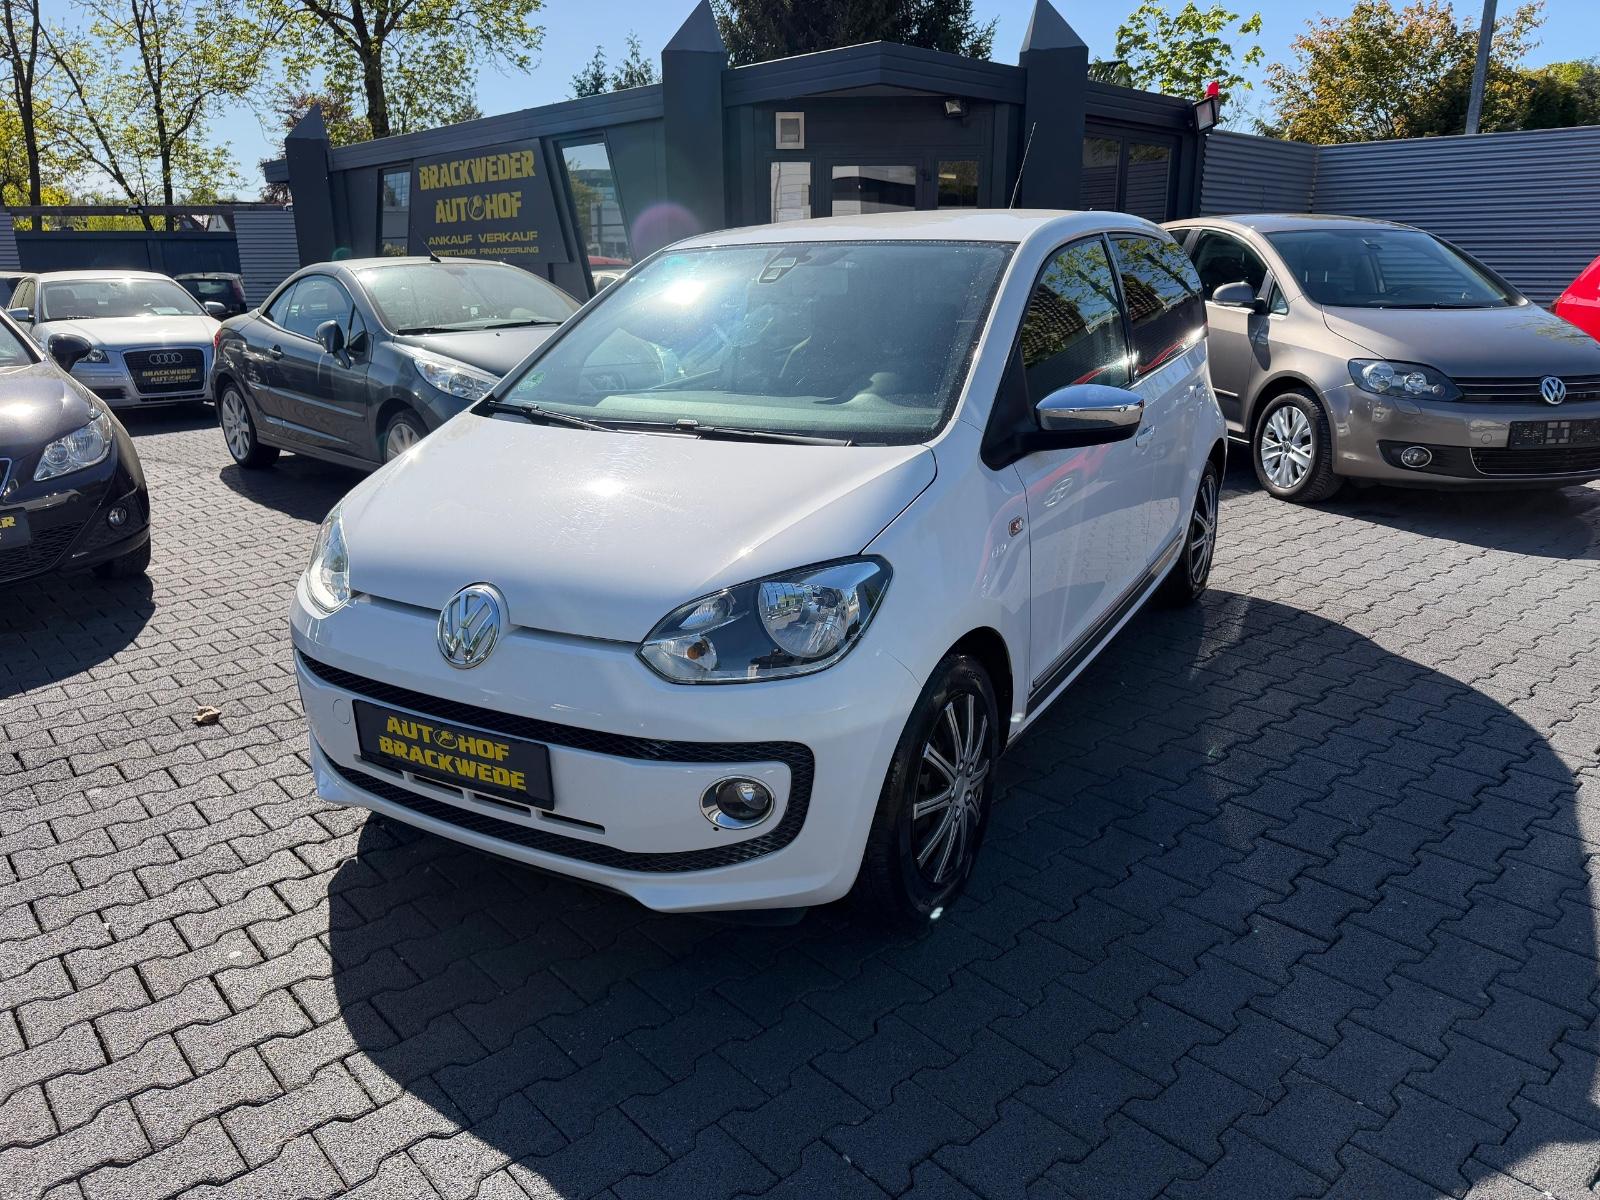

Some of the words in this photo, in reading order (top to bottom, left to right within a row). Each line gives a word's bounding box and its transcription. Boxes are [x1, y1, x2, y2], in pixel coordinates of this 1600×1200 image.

[419, 150, 536, 190] BRACKWEDER
[428, 234, 473, 246] ANKAUF
[478, 231, 538, 243] VERKAUF
[432, 249, 476, 257] ERMITTLUNG
[480, 246, 539, 255] FINANZIERUNG
[379, 735, 527, 790] BRACKWEDE
